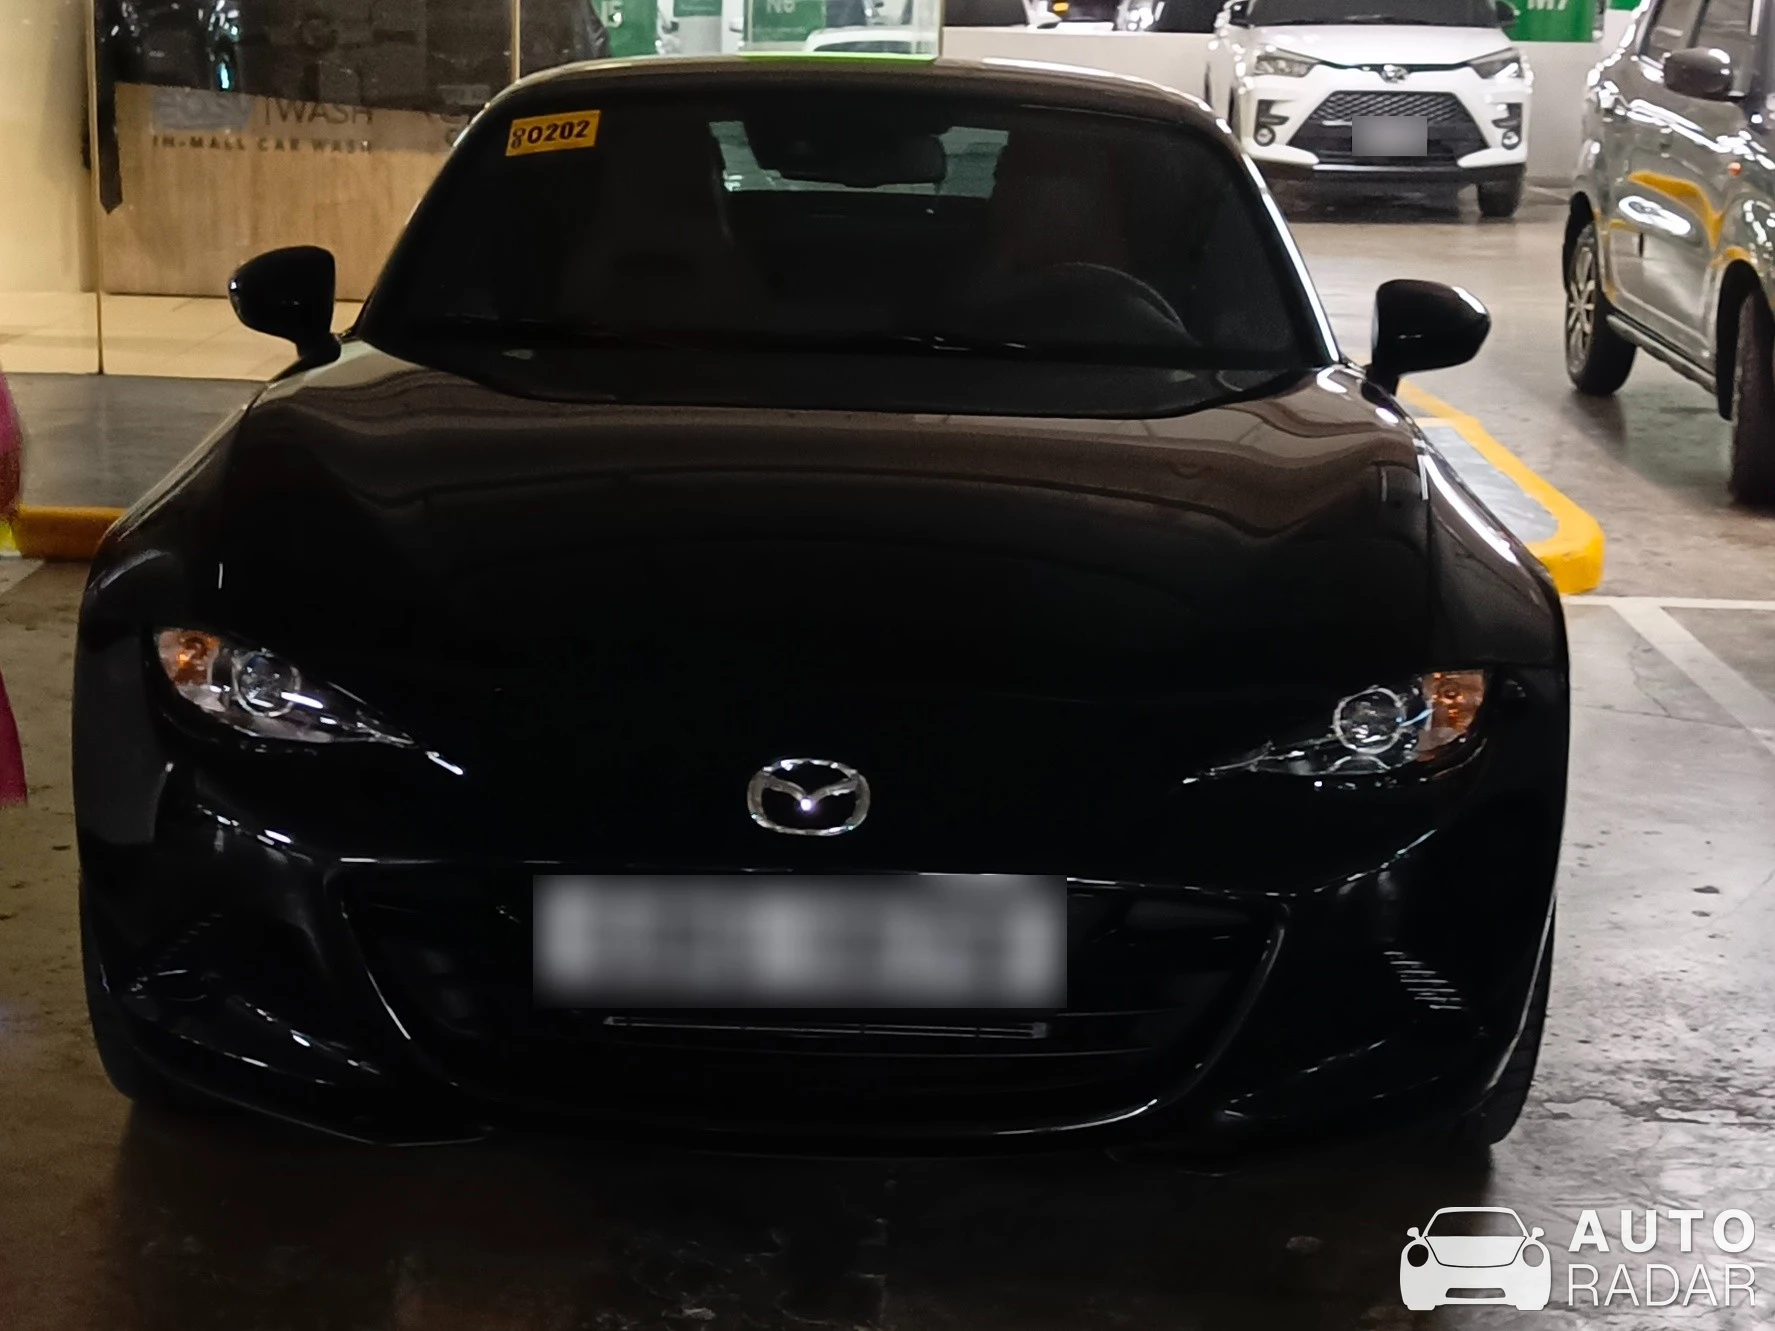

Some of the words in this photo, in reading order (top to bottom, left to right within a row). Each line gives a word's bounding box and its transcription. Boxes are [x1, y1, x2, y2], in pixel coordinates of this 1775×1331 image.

[275, 99, 372, 124] WASH
[152, 134, 246, 151] IN-MALL
[258, 137, 299, 152] CAR
[312, 138, 372, 154] WASH
